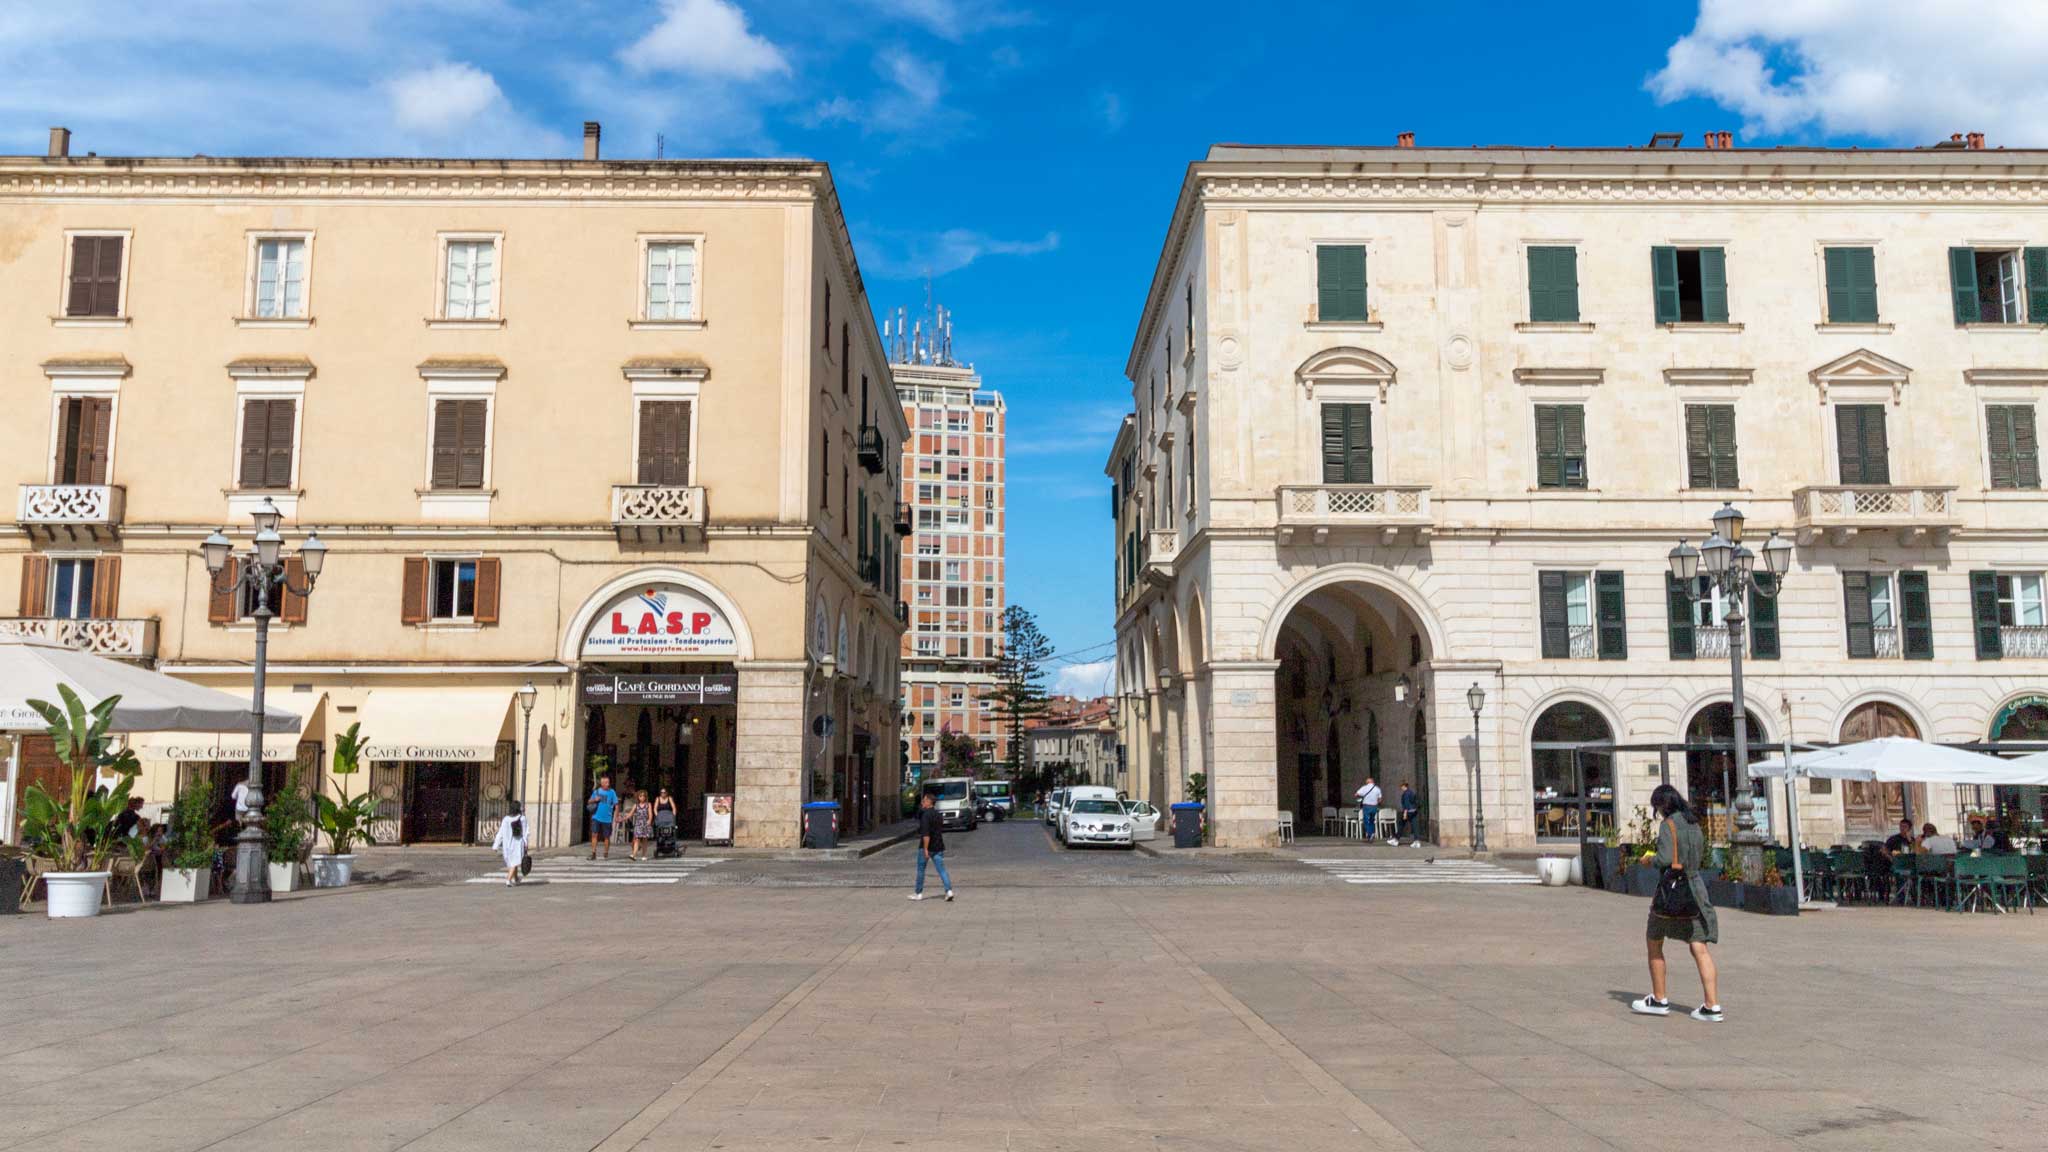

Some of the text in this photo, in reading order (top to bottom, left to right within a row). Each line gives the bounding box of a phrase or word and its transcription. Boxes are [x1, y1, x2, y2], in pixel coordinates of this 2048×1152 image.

[588, 637, 616, 645] Sistemi
[617, 637, 625, 645] di
[648, 681, 700, 692] GIORDANO
[207, 746, 278, 759] GIORDNO
[406, 745, 476, 758] GIORDANO
